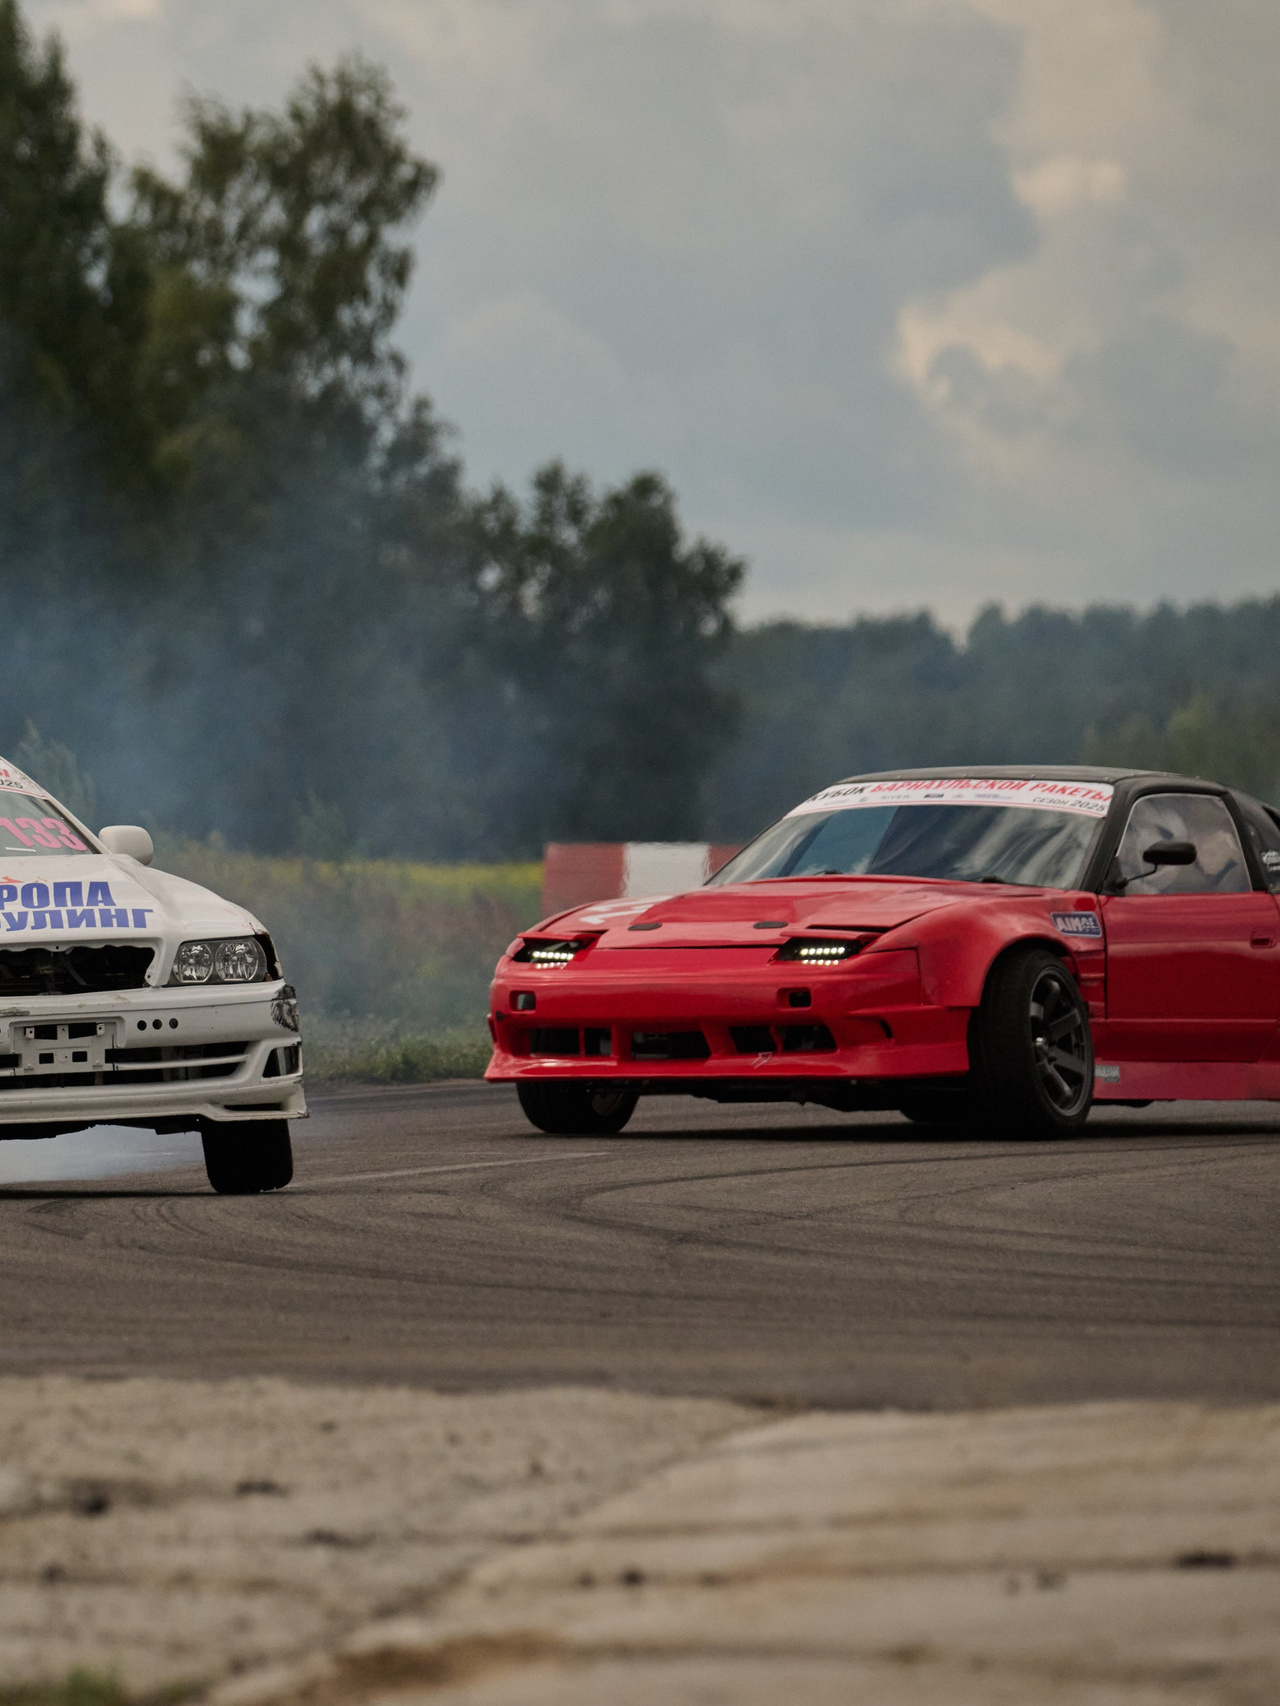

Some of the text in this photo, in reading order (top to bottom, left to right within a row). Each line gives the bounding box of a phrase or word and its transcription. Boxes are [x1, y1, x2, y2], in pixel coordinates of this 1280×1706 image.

[806, 785, 870, 803] КУБОК
[1029, 782, 1113, 802] РАКЕТЫ
[1032, 796, 1109, 812] СЕЗОН 2025
